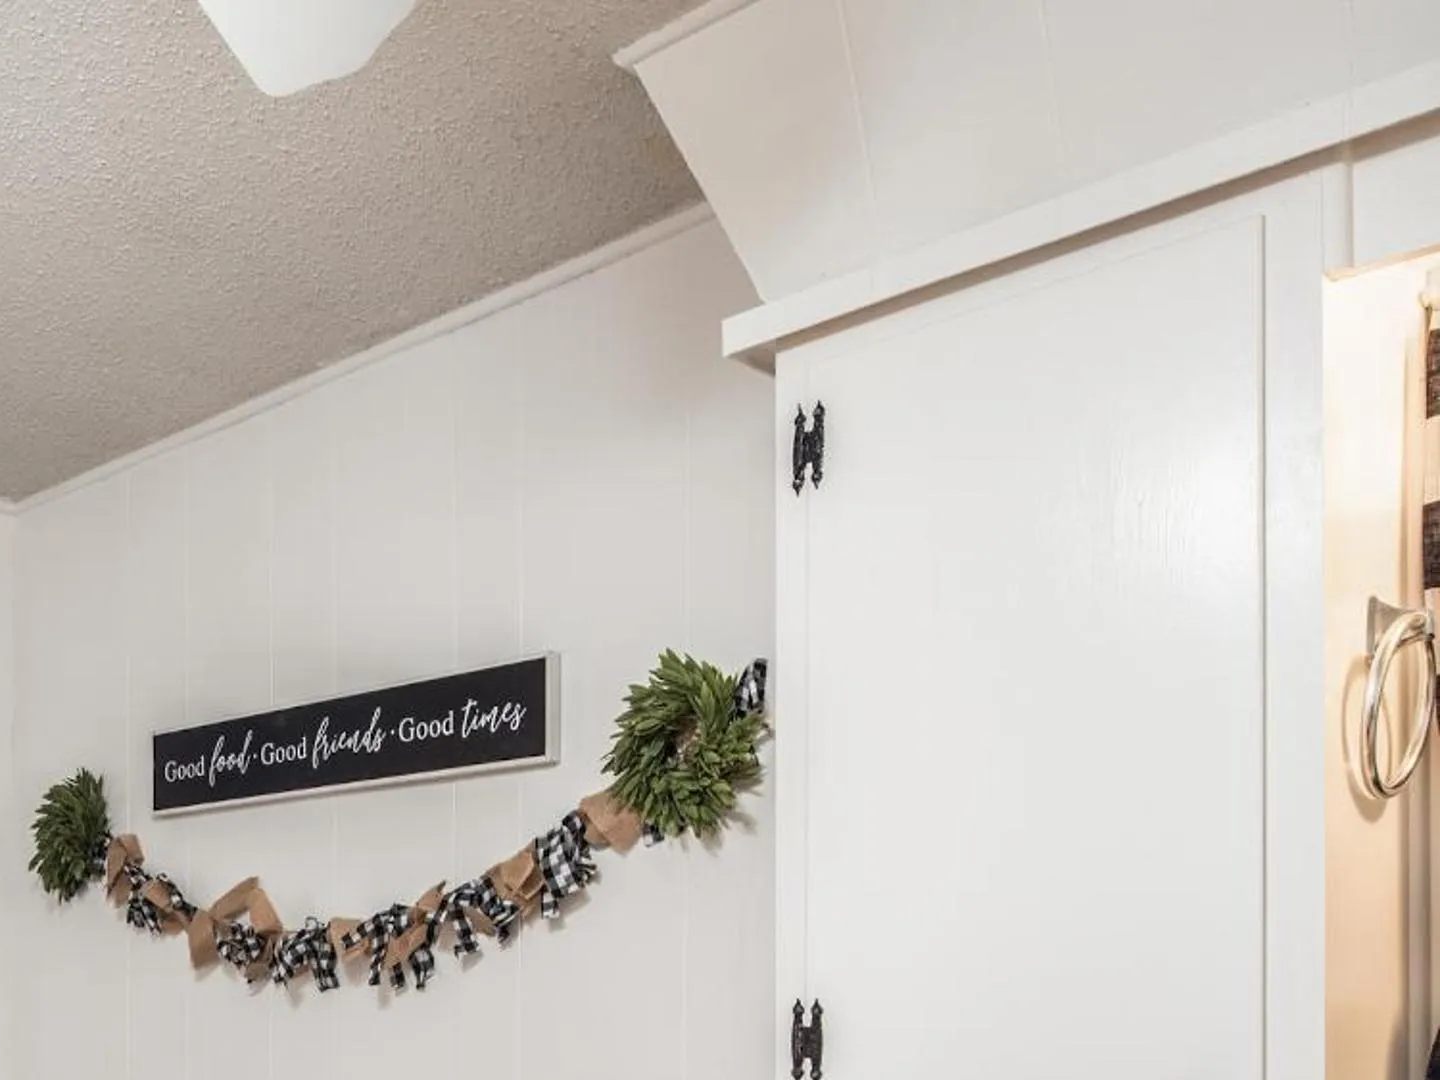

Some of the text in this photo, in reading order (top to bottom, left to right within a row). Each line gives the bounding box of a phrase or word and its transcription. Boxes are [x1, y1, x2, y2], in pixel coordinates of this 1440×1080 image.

[164, 697, 527, 788] Good food Good friends Good times
